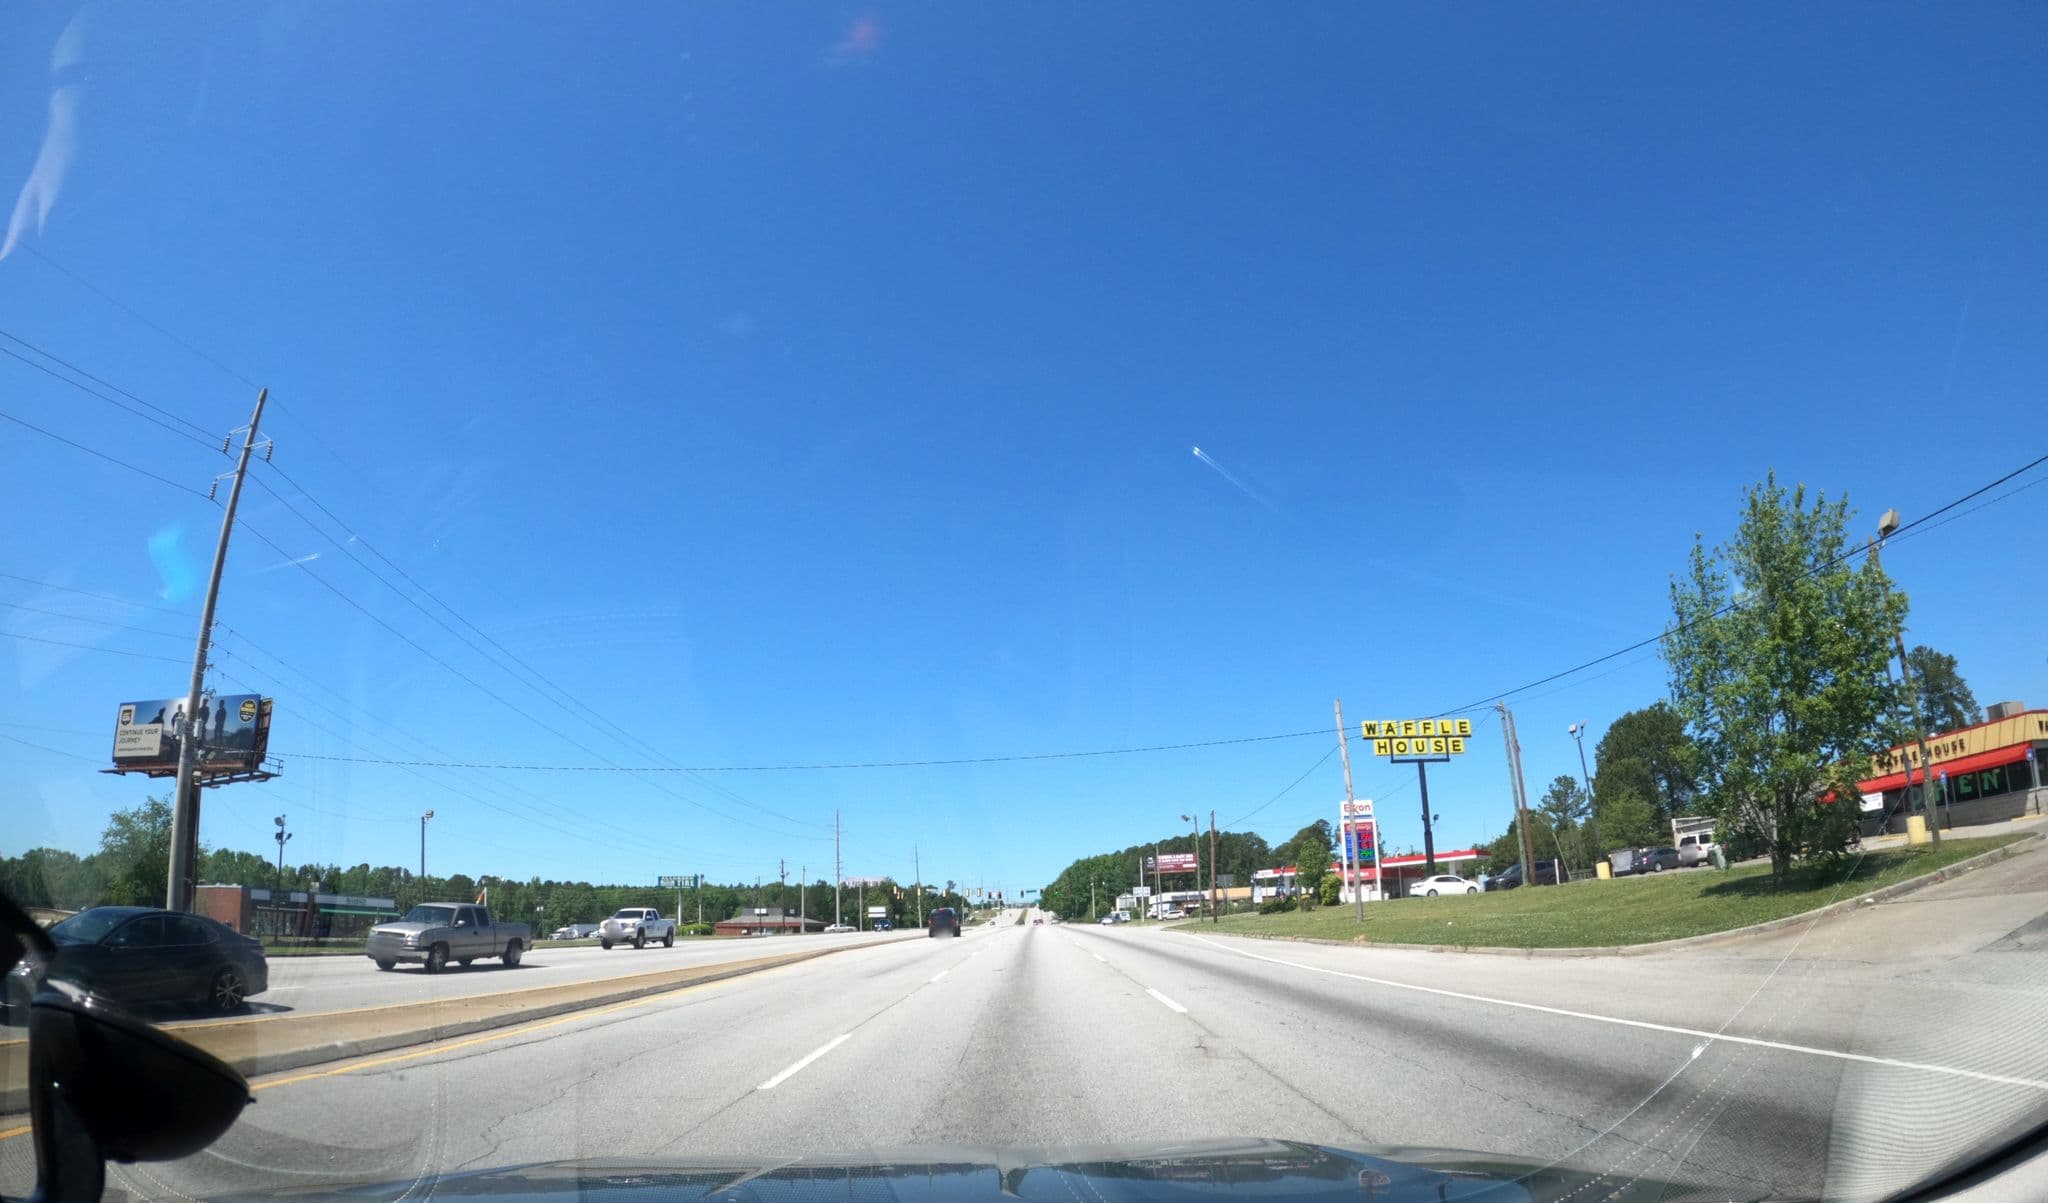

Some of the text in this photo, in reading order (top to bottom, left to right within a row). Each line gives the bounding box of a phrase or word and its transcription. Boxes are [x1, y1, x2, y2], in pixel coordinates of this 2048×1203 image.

[1365, 722, 1468, 735] WAFFLE
[1377, 740, 1462, 754] HOUSE
[1927, 738, 1965, 759] HOUSE
[1343, 803, 1371, 815] Exon
